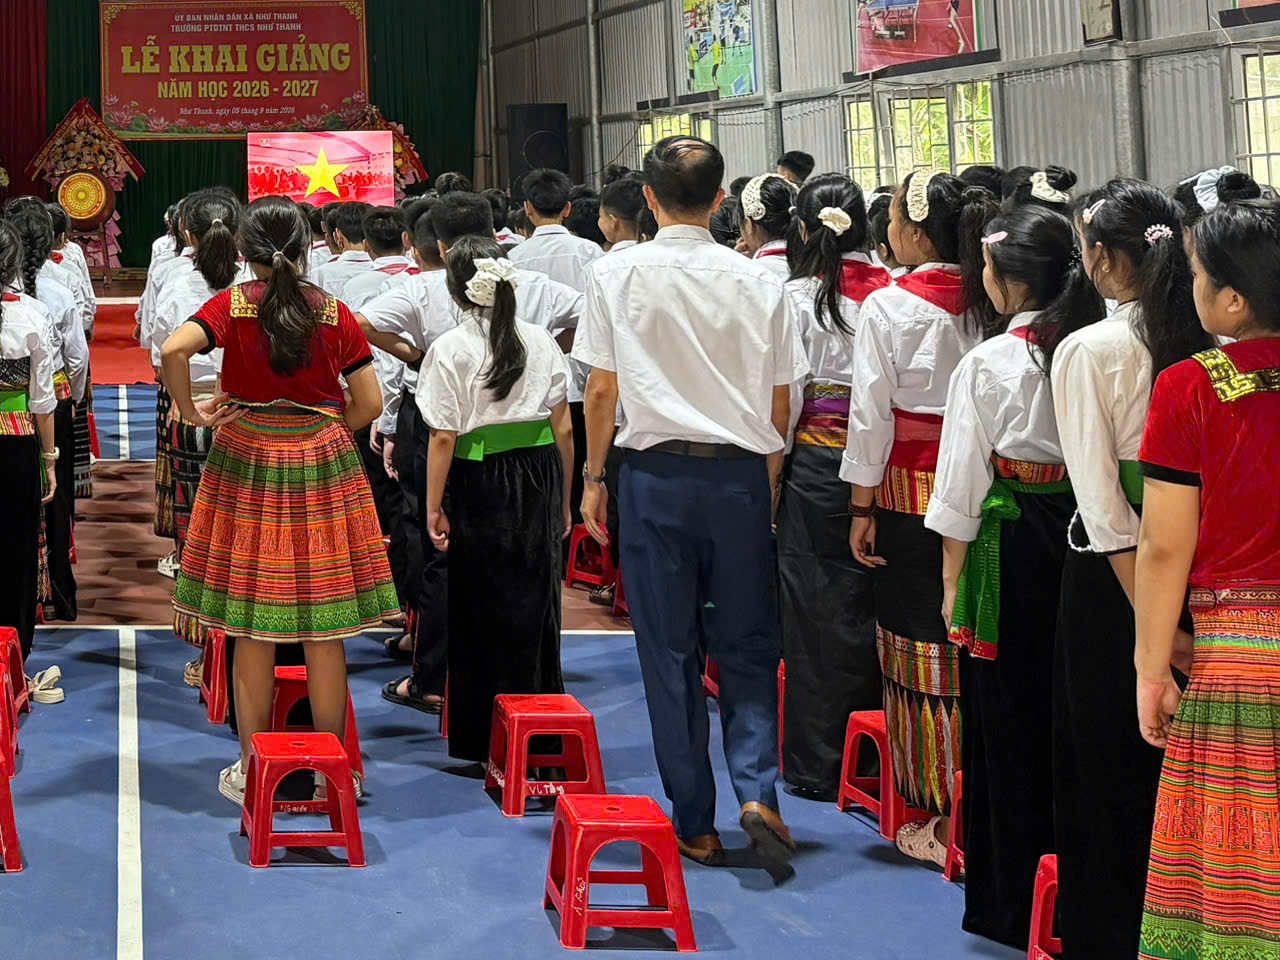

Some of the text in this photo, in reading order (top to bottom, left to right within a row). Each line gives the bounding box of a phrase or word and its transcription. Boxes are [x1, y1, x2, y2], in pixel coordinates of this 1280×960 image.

[186, 14, 202, 22] BAN
[204, 12, 225, 22] NHÂN
[226, 12, 242, 21] DÂN
[256, 12, 272, 20] NHƯ
[273, 12, 298, 20] THANH
[204, 24, 233, 32] PTDTNT
[235, 23, 255, 32] THCS
[257, 22, 274, 31] NHƯ
[276, 22, 302, 31] THANH
[120, 34, 351, 74] LỄ KHAI GIẢNG
[157, 77, 193, 98] NĂM
[198, 80, 228, 101] HỌC
[232, 80, 270, 98] 2026
[282, 79, 319, 97] 2027
